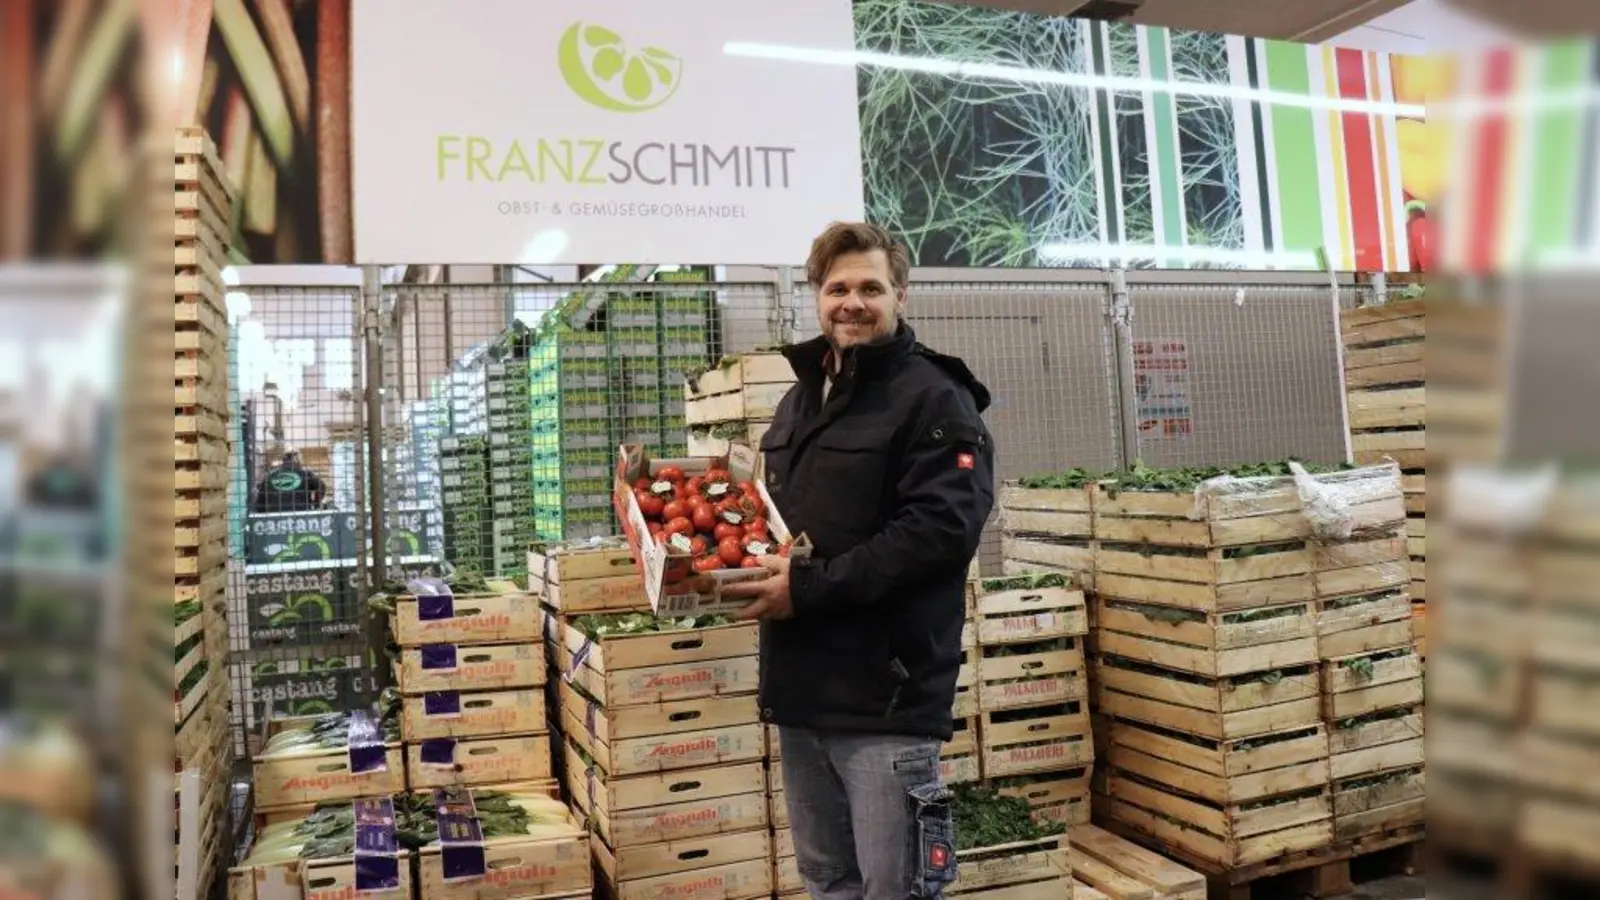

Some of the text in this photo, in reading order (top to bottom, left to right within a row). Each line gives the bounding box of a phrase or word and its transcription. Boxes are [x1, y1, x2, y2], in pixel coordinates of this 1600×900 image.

[551, 202, 562, 216] &
[254, 515, 333, 536] castang
[247, 570, 335, 593] castang
[250, 676, 338, 701] castang
